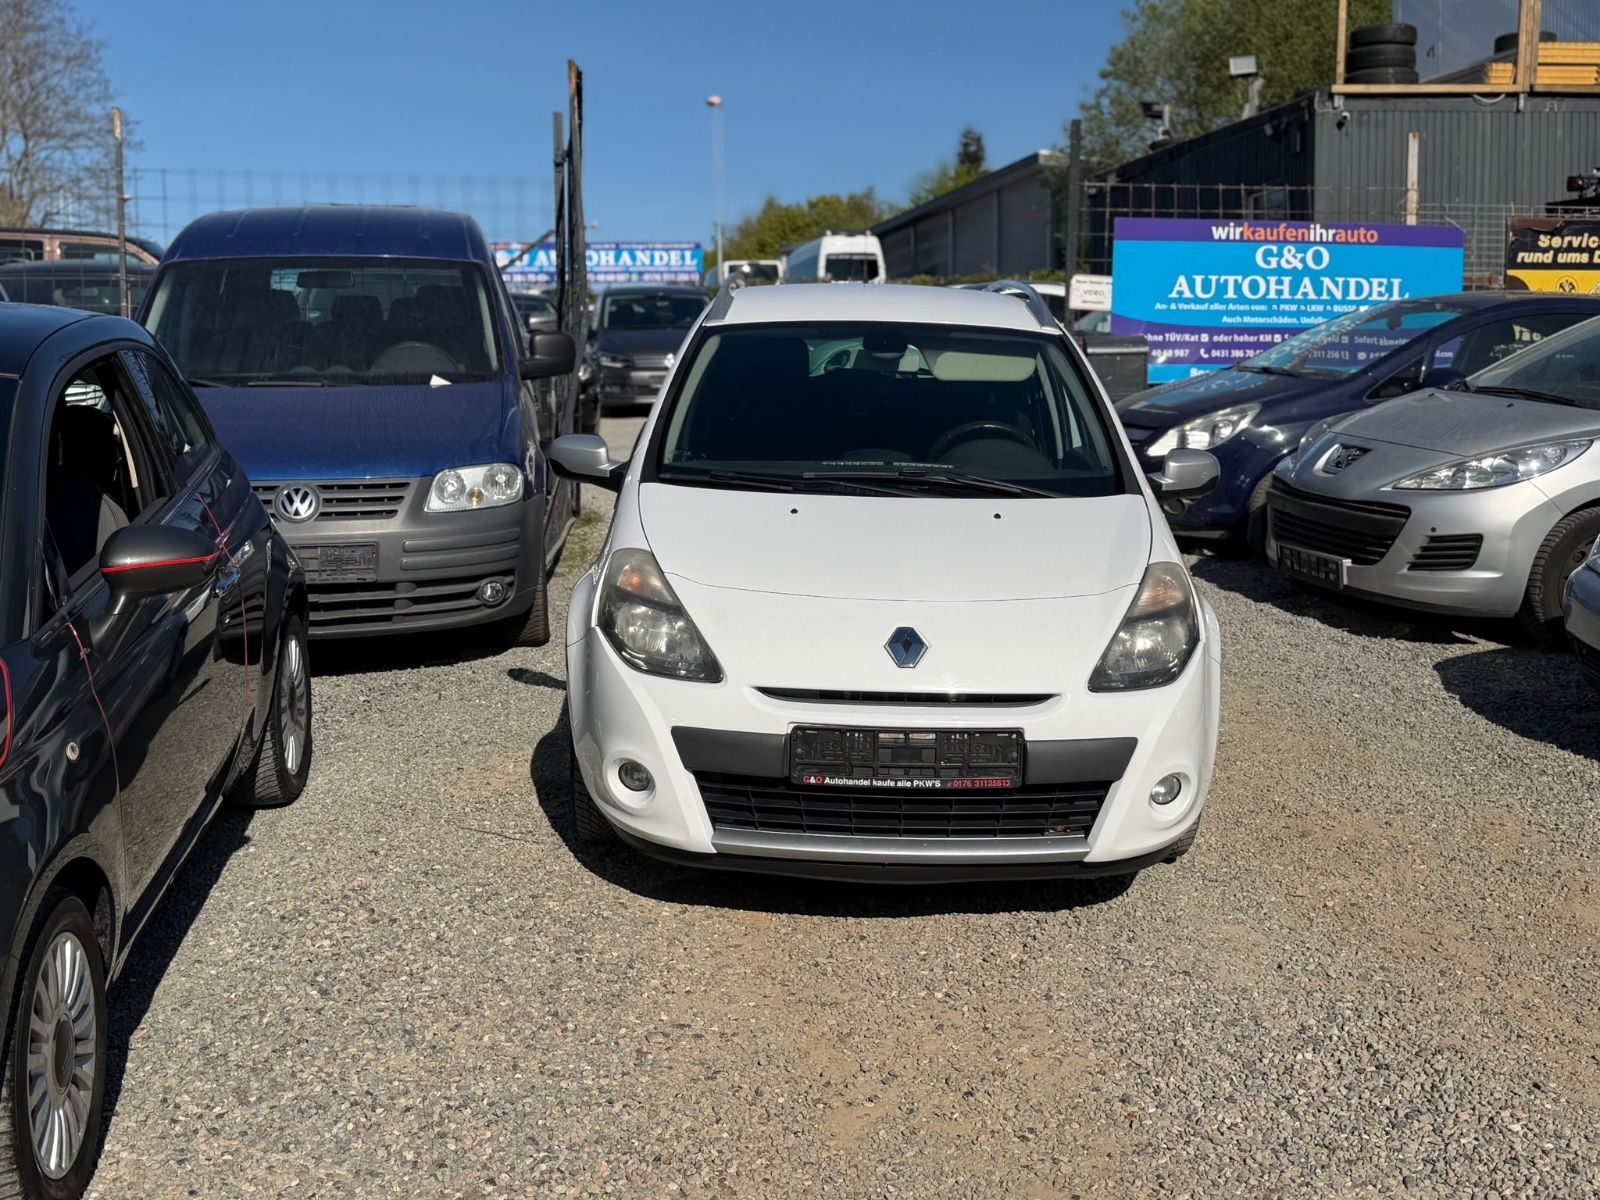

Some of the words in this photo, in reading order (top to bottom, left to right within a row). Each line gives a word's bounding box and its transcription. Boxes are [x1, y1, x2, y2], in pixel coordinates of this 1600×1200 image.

[1211, 222, 1379, 243] wirkaufenihrauto
[1537, 233, 1600, 248] Servic
[1255, 245, 1330, 270] G&O
[1516, 250, 1554, 263] rund
[1557, 251, 1590, 263] ums
[1168, 275, 1410, 301] AUTOHANDEL
[1154, 302, 1169, 310] An-
[1170, 302, 1177, 310] &
[1177, 302, 1209, 310] Verkauf
[1209, 303, 1227, 311] aller
[1227, 303, 1250, 311] Arten
[1280, 304, 1298, 312] PKW
[1307, 304, 1324, 312] LKW
[1222, 315, 1242, 323] Auch
[1164, 331, 1199, 342] TÜV/Kat
[1212, 333, 1232, 342] oder
[1233, 333, 1258, 342] hoher
[1259, 333, 1272, 342] KM
[1353, 335, 1378, 345] Sofort
[803, 775, 823, 784] G&O
[823, 776, 871, 786] Autohandel
[872, 778, 896, 787] kaufe
[896, 779, 912, 787] alle
[913, 780, 941, 788] PKW'S
[953, 780, 972, 788] 0176
